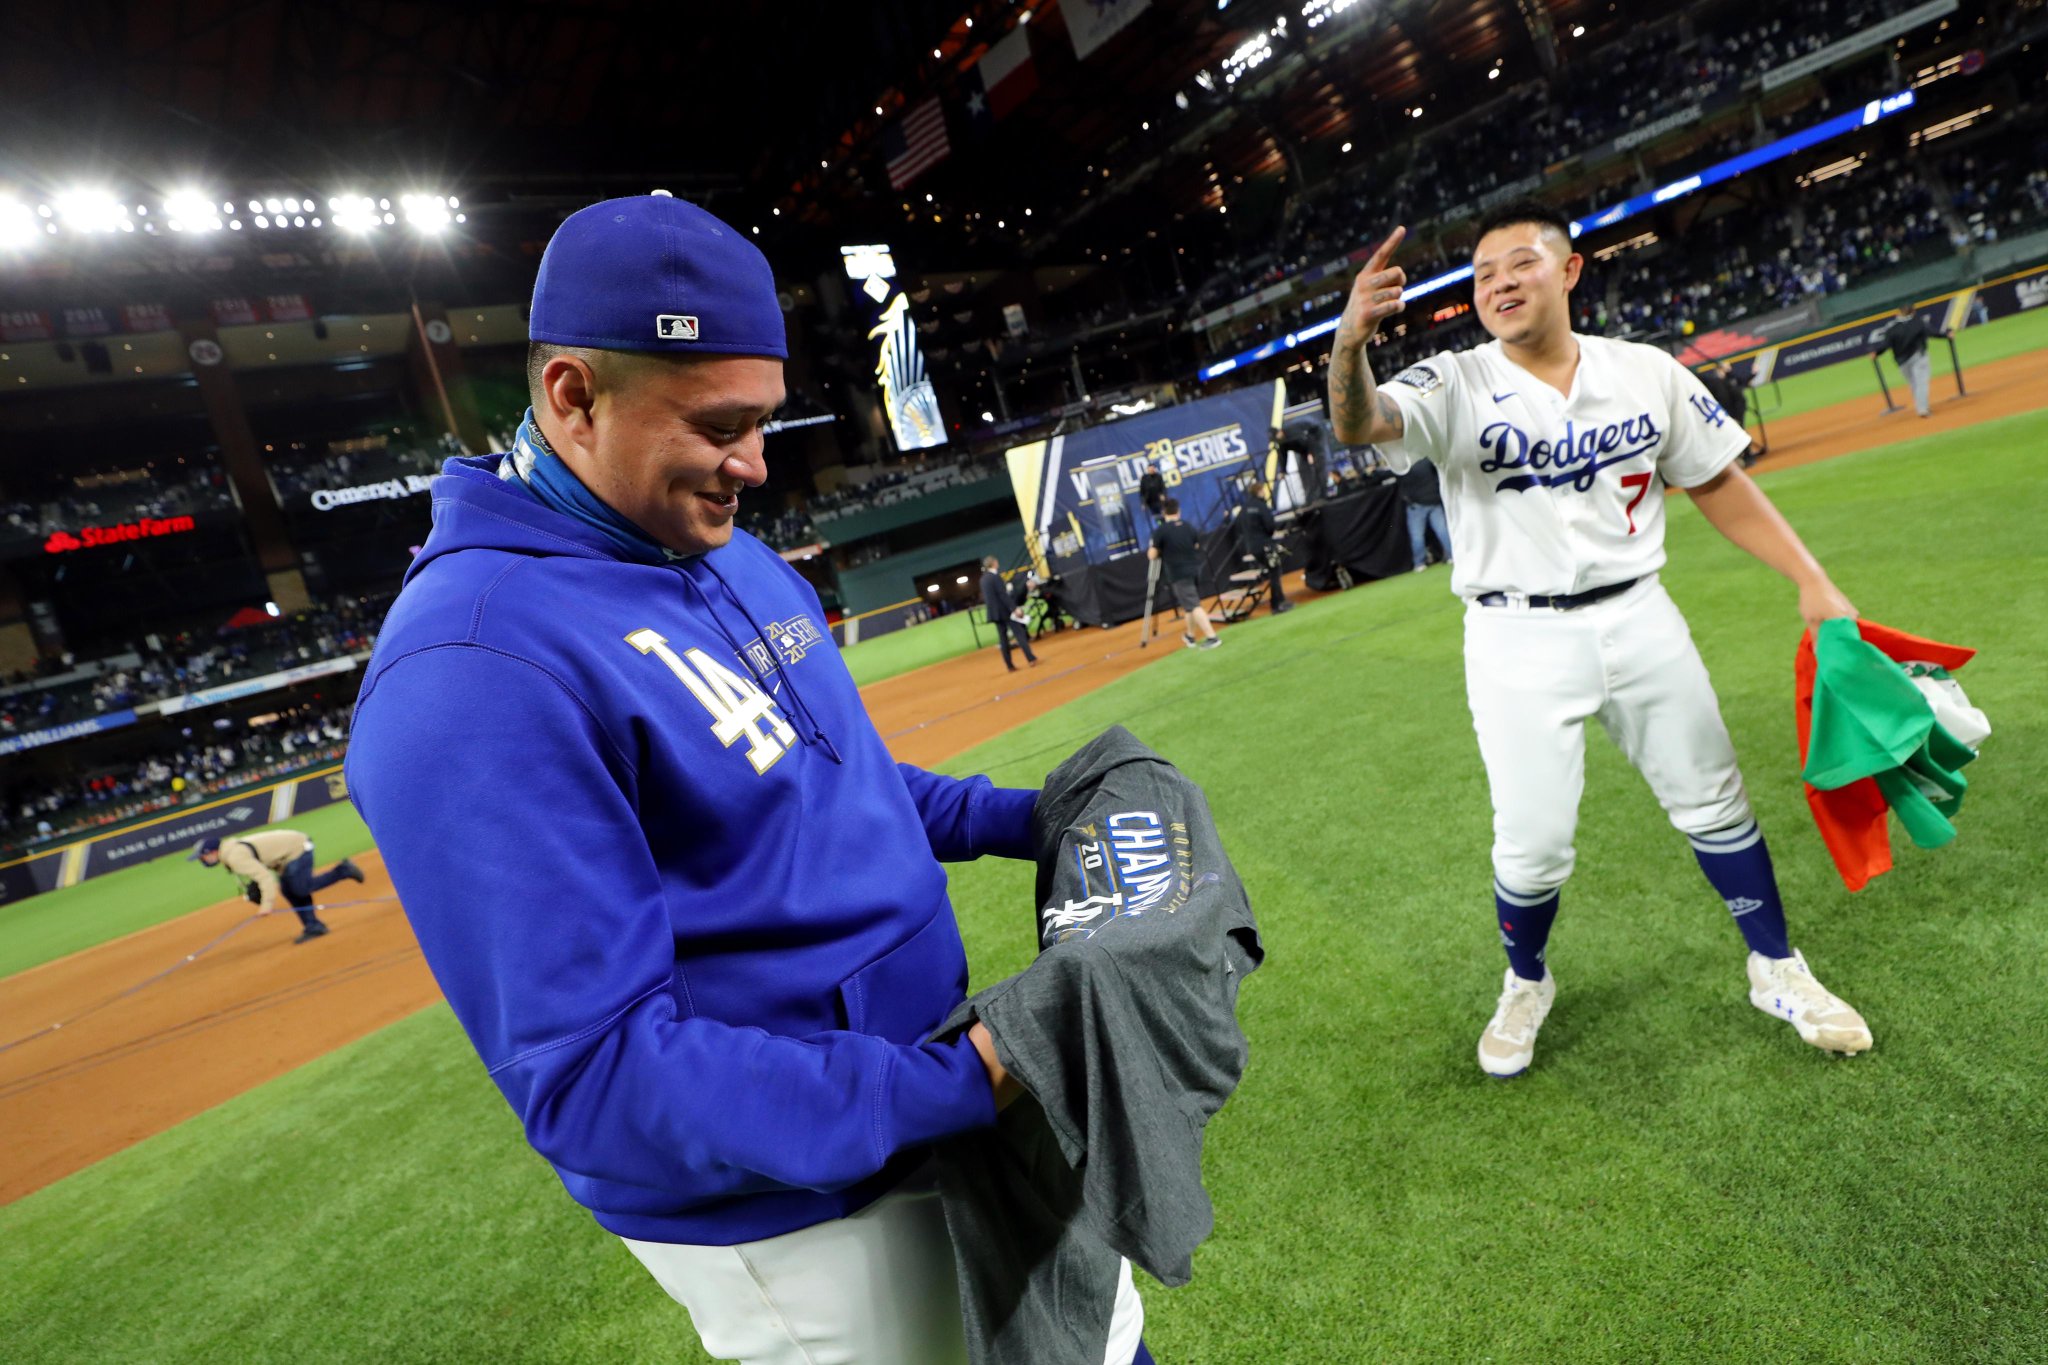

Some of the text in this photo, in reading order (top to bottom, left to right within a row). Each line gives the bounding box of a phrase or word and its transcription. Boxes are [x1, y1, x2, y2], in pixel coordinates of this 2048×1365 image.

[1070, 427, 1248, 501] WLD SERIES
[1145, 438, 1173, 461] 20
[1480, 412, 1661, 493] Dodgers
[1621, 472, 1651, 535] 7
[764, 621, 785, 640] 20
[783, 644, 807, 665] 20
[623, 627, 798, 776] LA
[107, 840, 147, 861] BANK
[168, 817, 228, 842] AMERICA
[1081, 842, 1103, 870] 20
